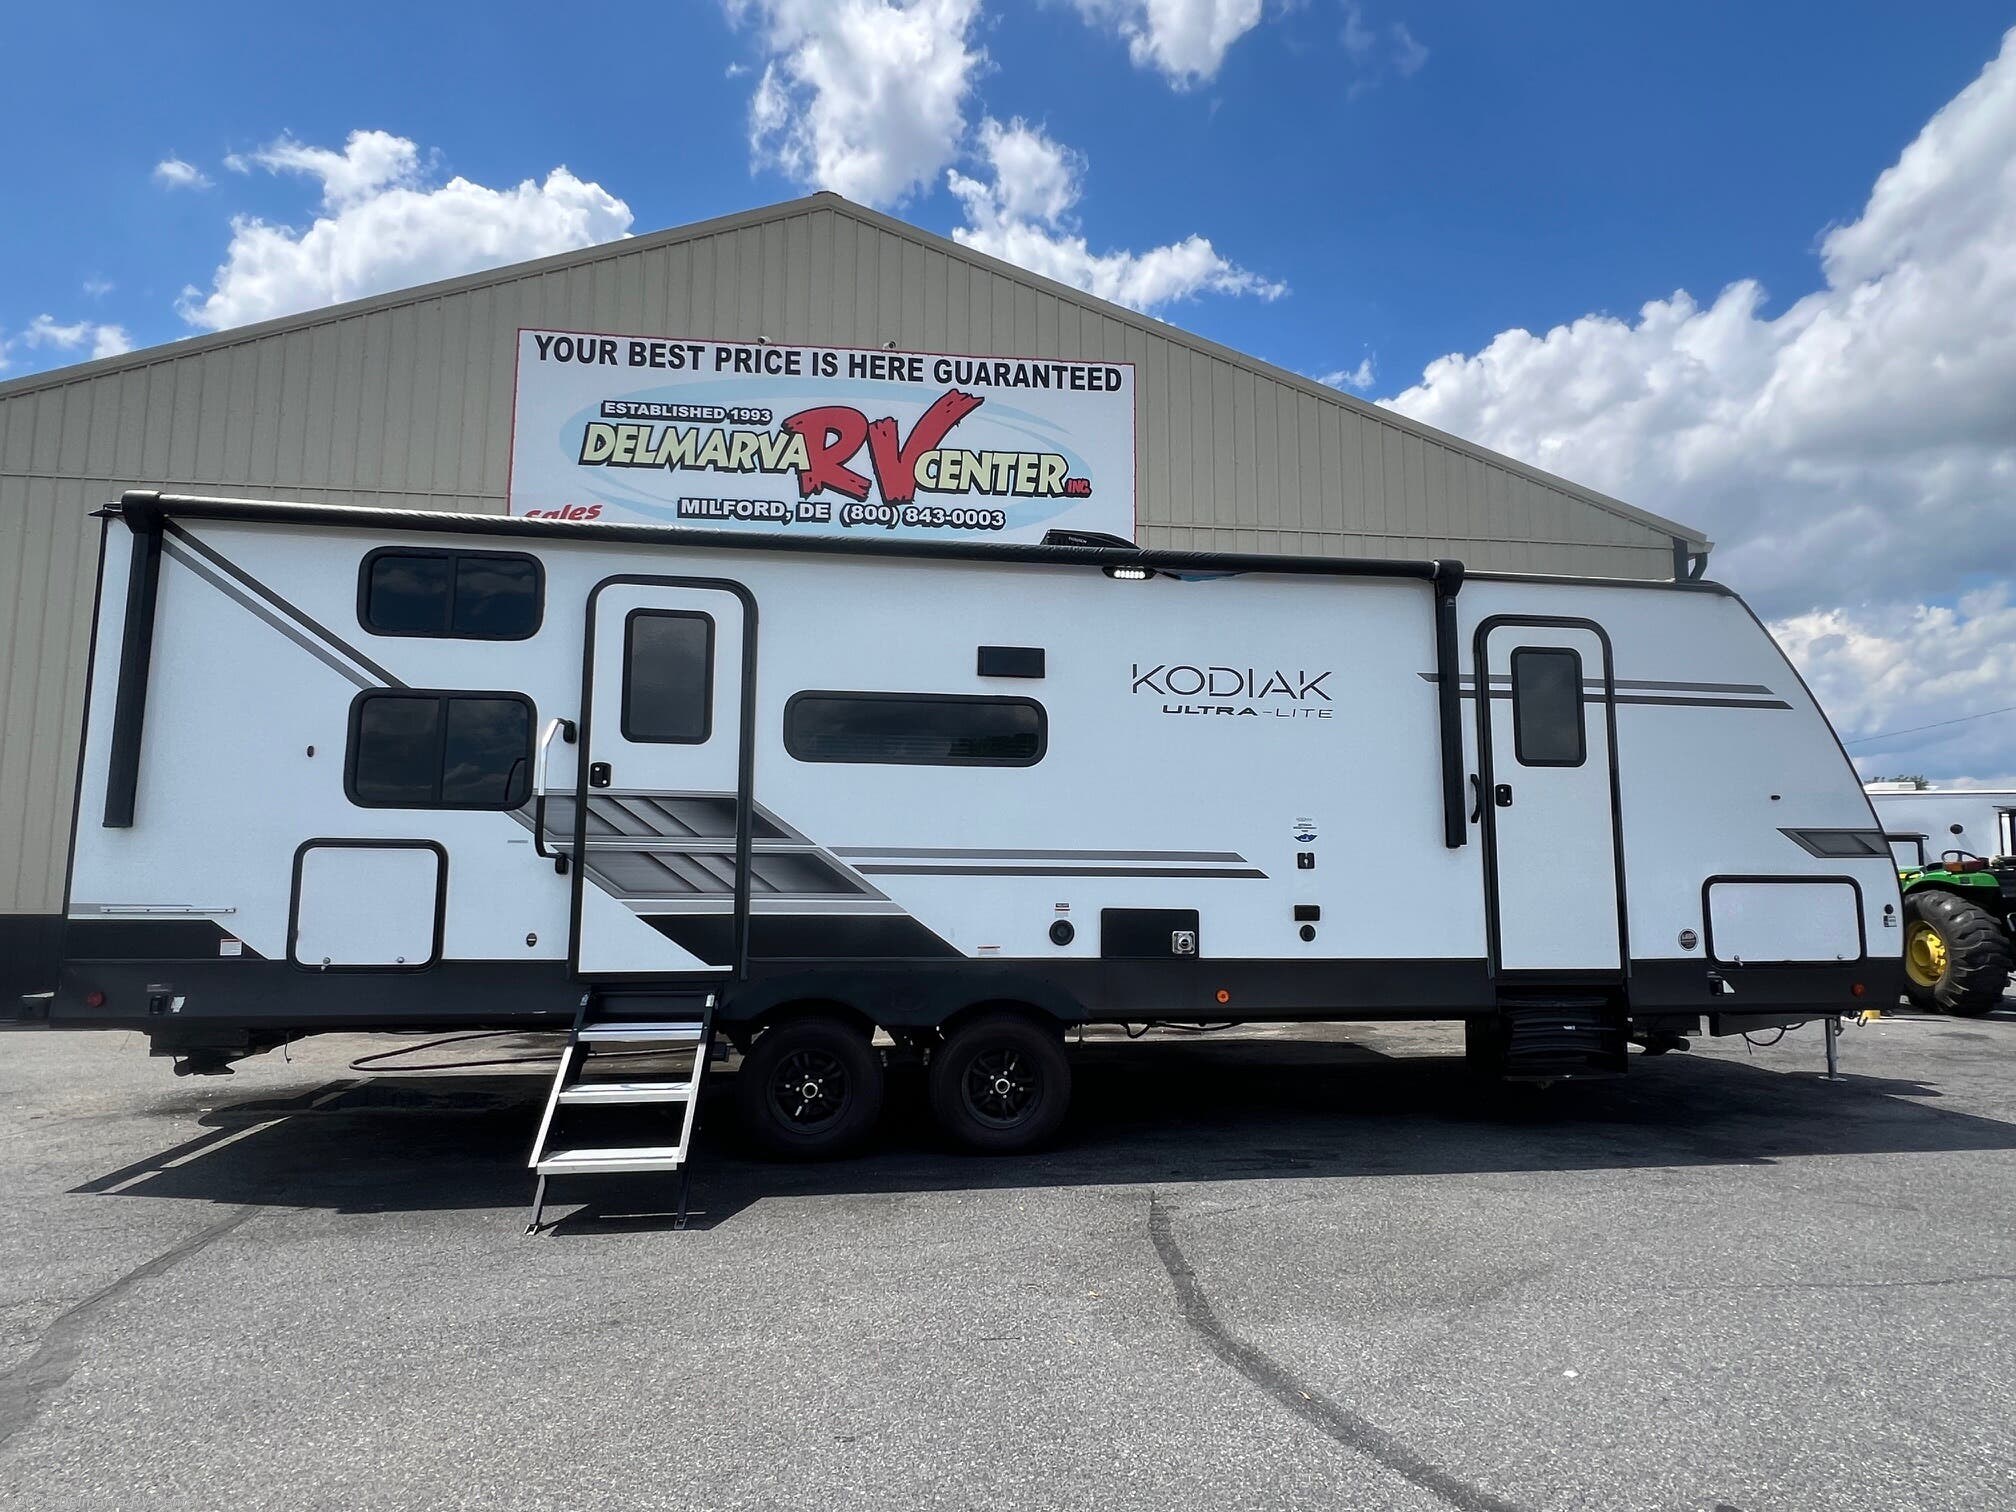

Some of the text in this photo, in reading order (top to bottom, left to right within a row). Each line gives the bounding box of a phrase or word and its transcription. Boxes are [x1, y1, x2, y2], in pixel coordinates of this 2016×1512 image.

[534, 334, 1122, 392] YOUR BEST PRICE IS HERE GUARANTEED
[603, 401, 772, 422] ESTABLISHED 1993
[580, 423, 811, 473] DELMARVA
[782, 389, 985, 505] RV
[913, 449, 1068, 495] CENTER
[681, 499, 1005, 527] MILFORD, DE (800) 843-0003
[1132, 663, 1333, 701] KODIAK
[1163, 704, 1333, 719] ULTRA-LITE
